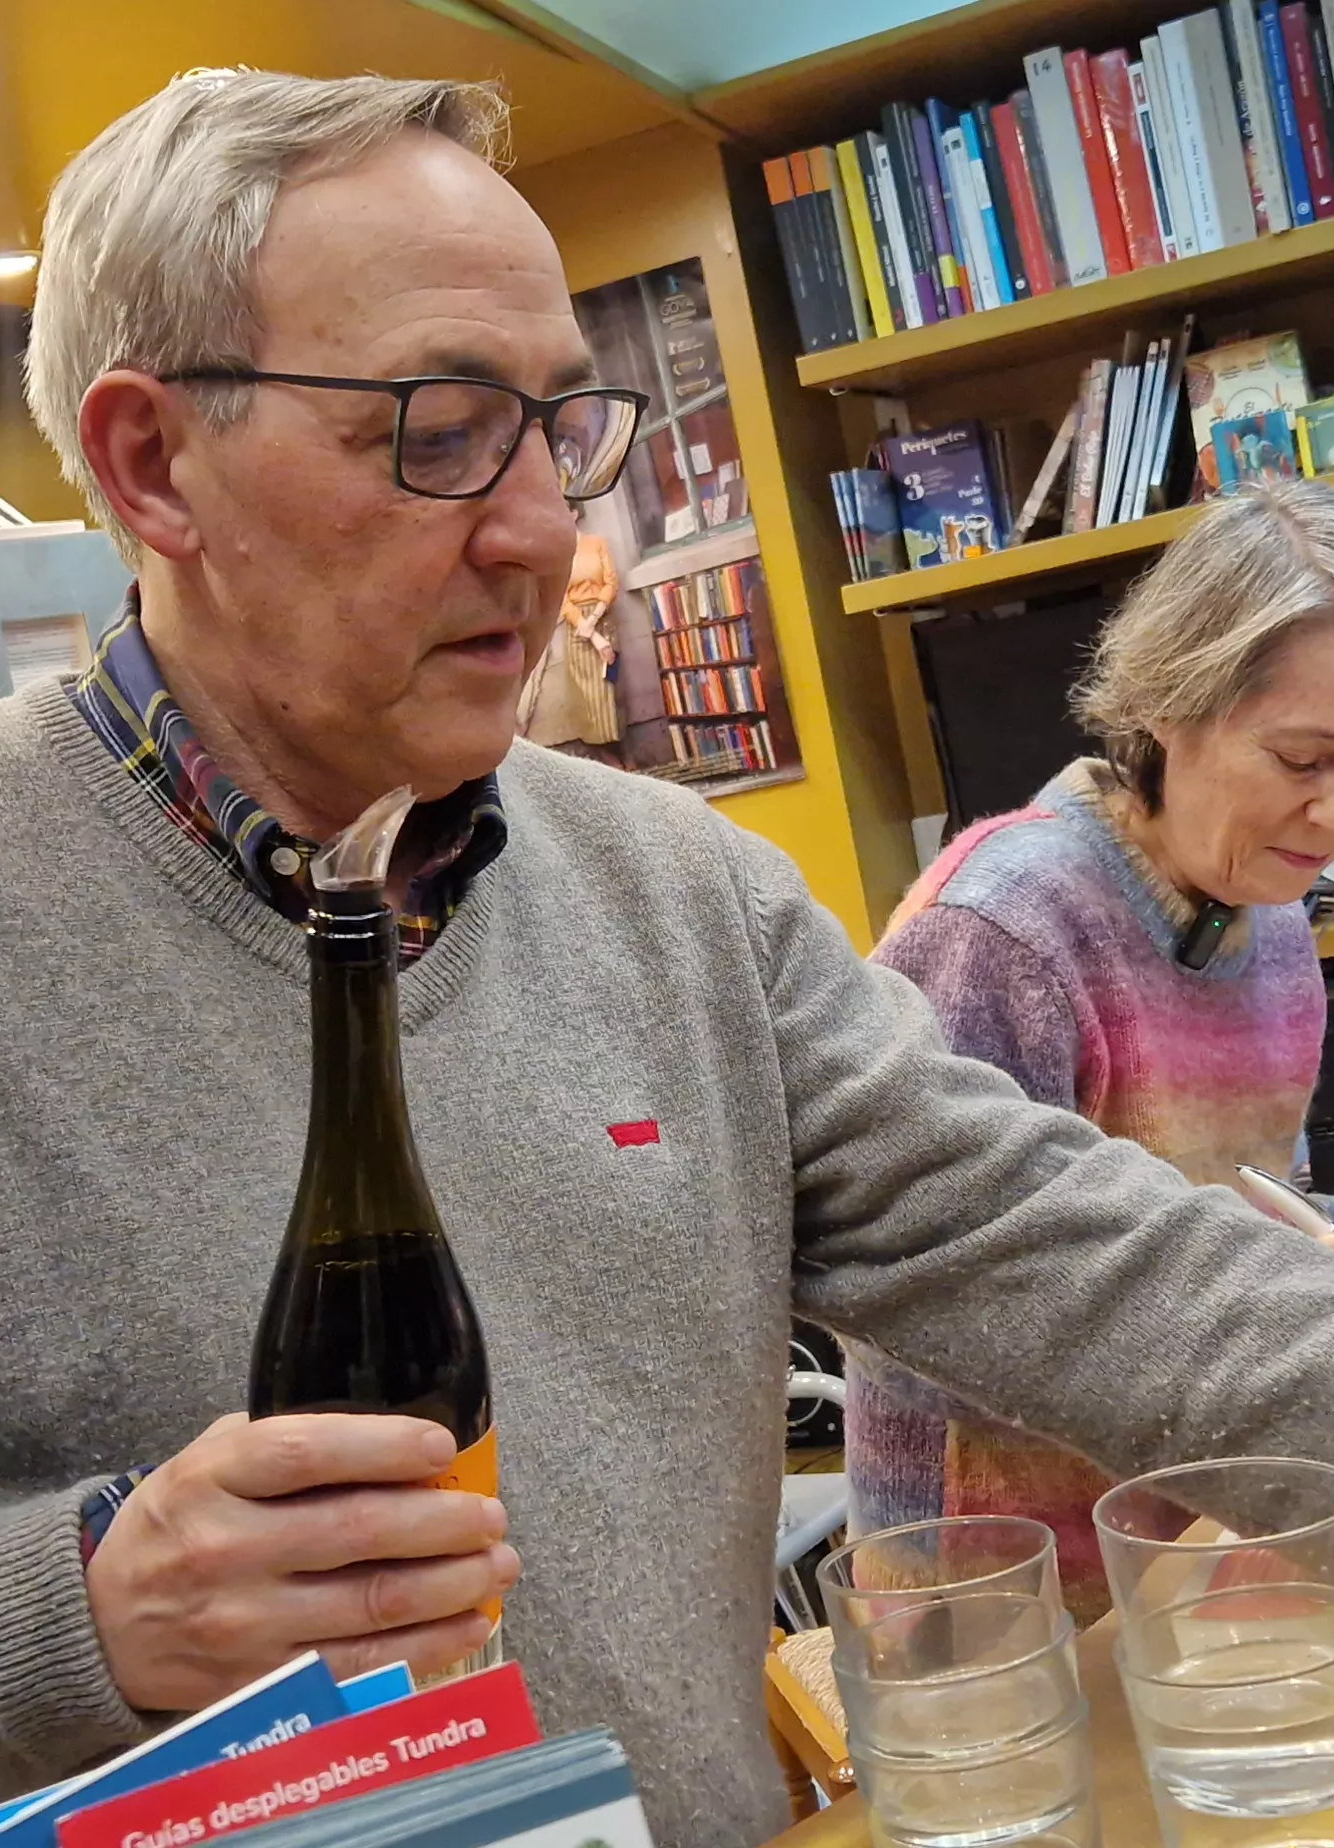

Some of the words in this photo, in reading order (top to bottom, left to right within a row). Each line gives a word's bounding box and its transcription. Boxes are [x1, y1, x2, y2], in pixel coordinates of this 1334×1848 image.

[903, 473, 925, 501] 3
[208, 1750, 391, 1831] desplegables
[389, 1716, 488, 1765] Tundra
